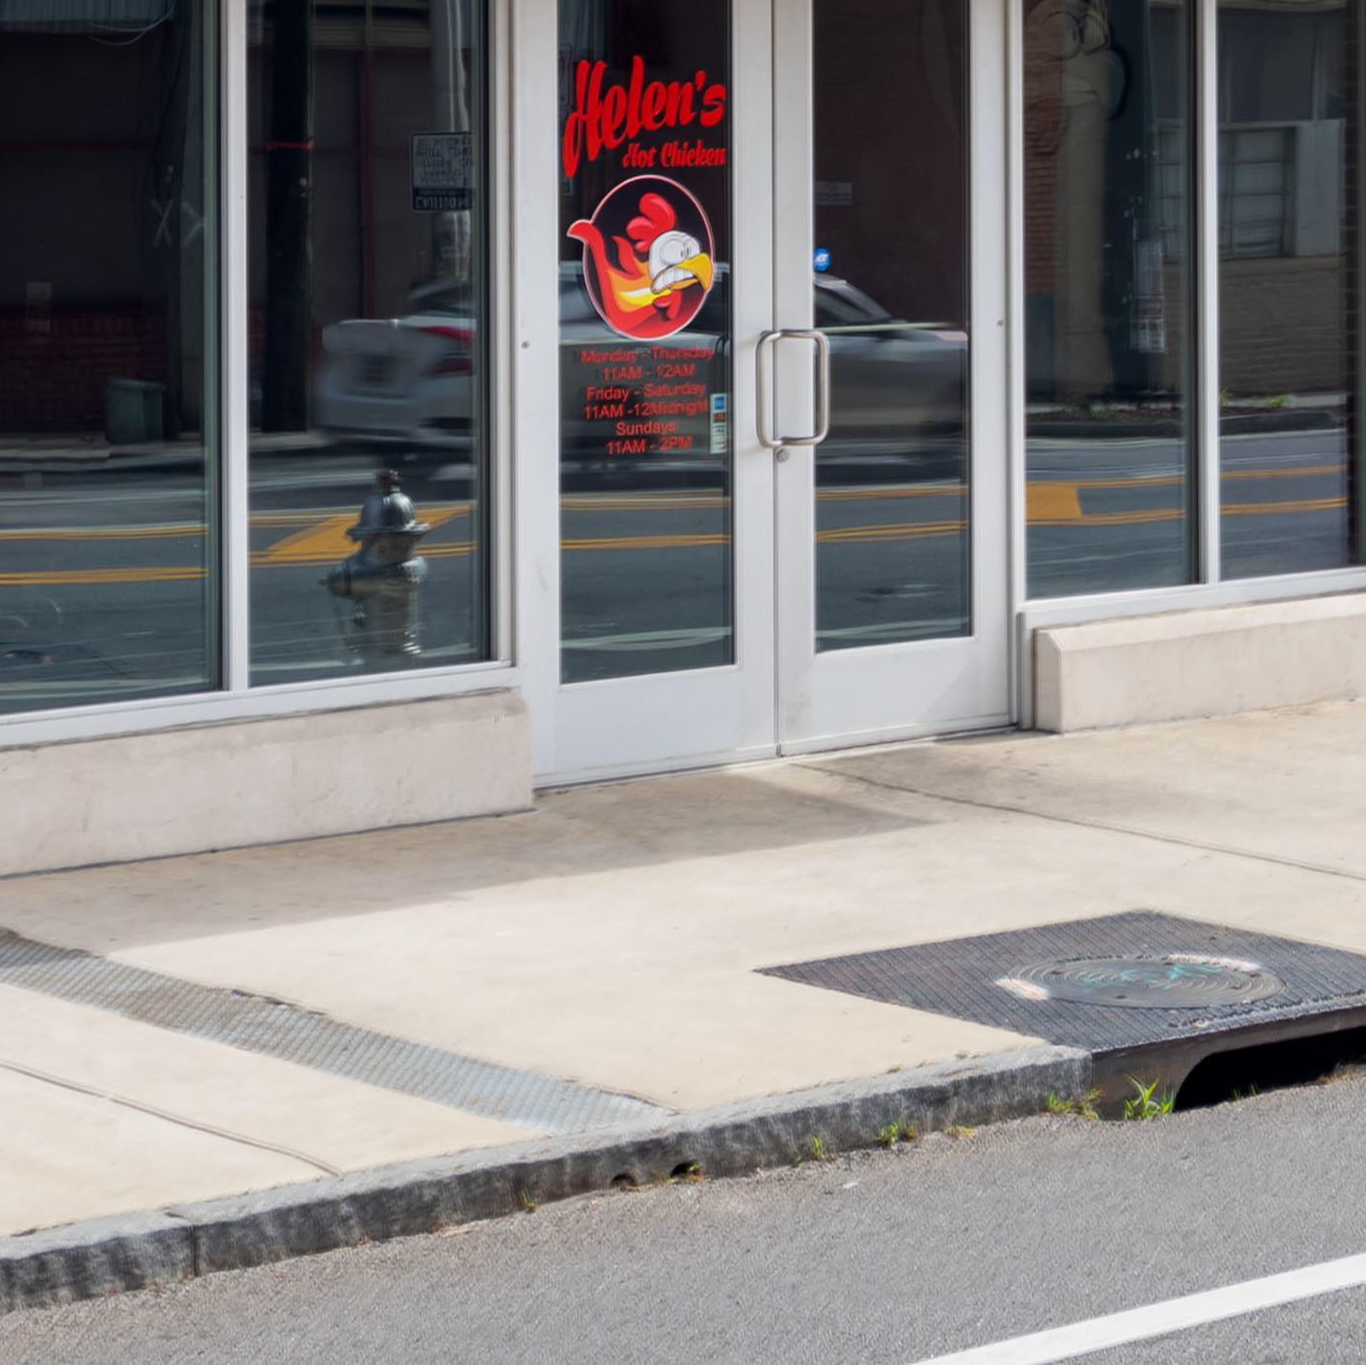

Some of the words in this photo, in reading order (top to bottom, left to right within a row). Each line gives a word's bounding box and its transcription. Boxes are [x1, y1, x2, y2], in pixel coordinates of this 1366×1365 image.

[563, 54, 726, 178] Helen's
[622, 143, 657, 167] Hot
[660, 140, 727, 167] Chicken
[580, 350, 638, 362] Monday
[652, 346, 716, 361] Thursday
[602, 366, 642, 379] 11AM
[656, 364, 696, 377] 12AM
[586, 386, 630, 401] Friday
[644, 382, 706, 397] Saturday
[584, 405, 624, 419] 11AM
[615, 421, 676, 435] Sundays
[607, 440, 646, 454] 11AM
[658, 437, 693, 451] 2PM
